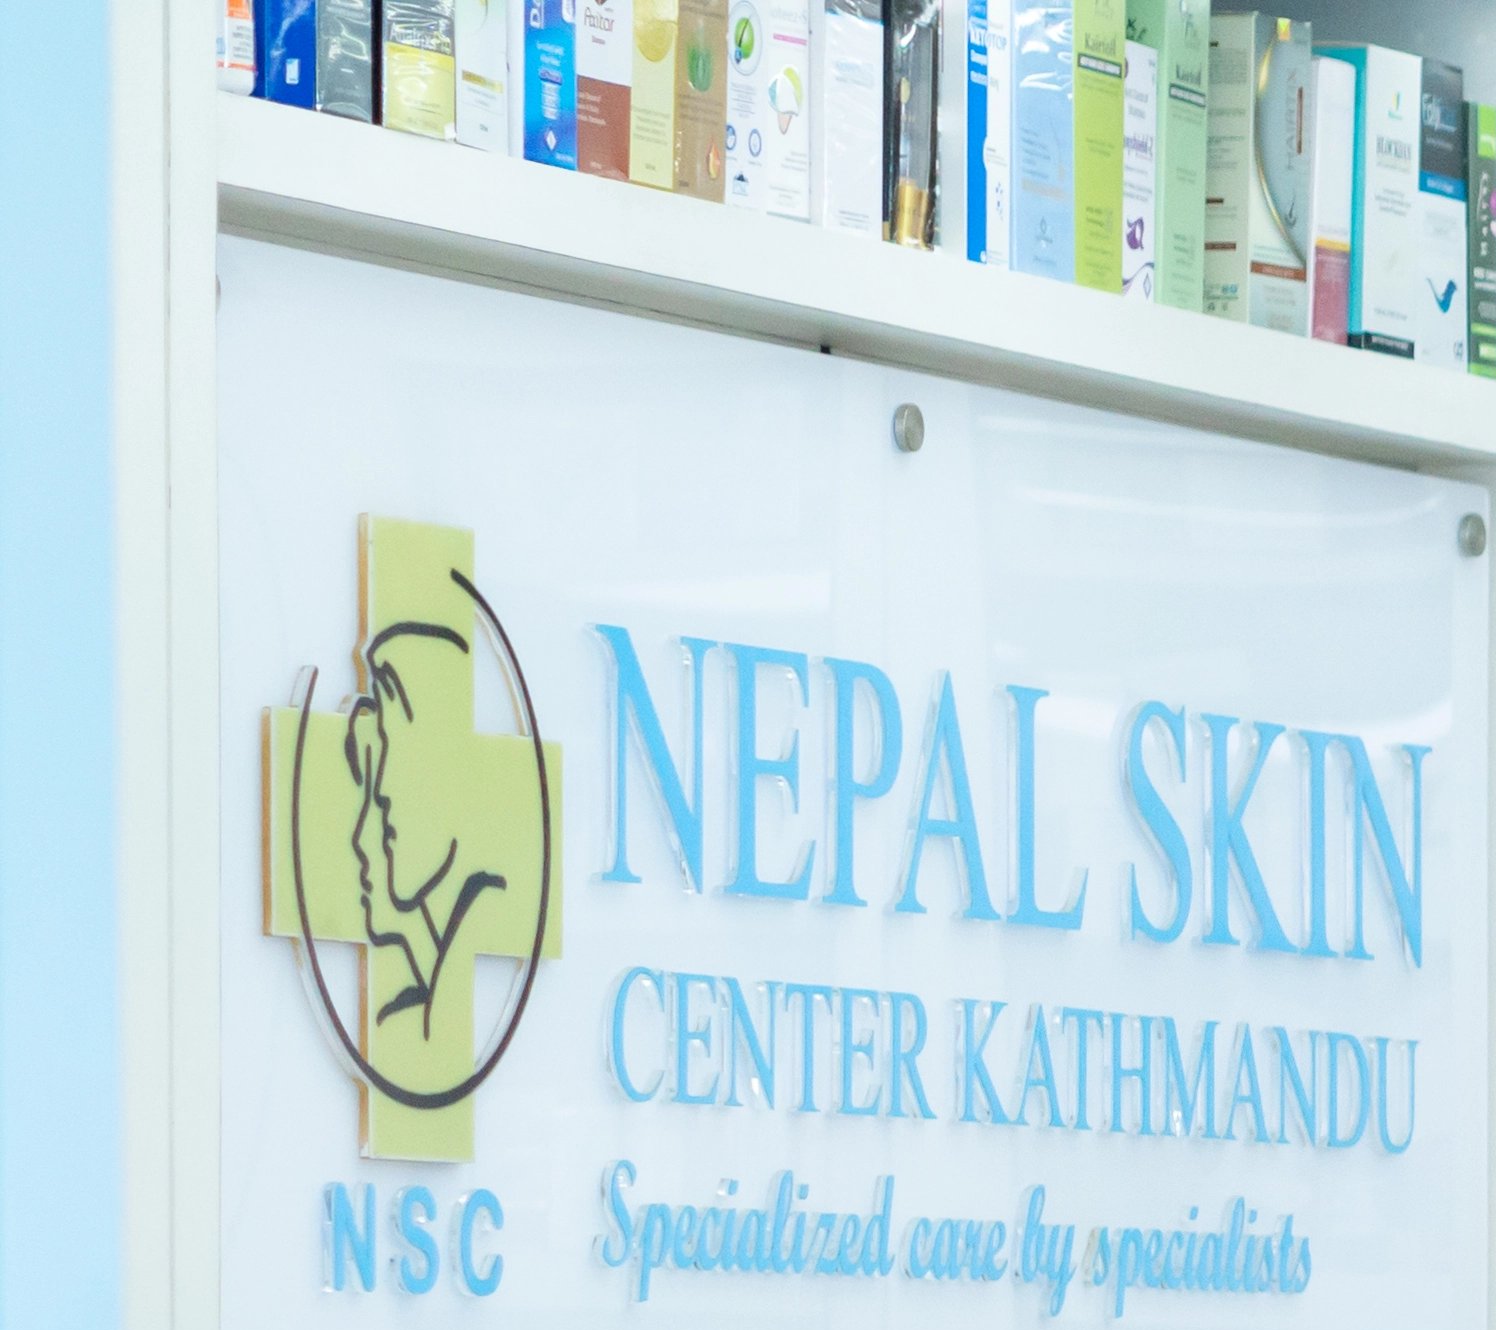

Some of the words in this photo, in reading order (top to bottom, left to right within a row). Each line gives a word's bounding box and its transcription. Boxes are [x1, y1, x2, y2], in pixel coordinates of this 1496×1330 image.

[588, 622, 1088, 934] NEPAL
[1118, 699, 1435, 970] SKIN
[605, 963, 936, 1122] CENTER
[954, 995, 1420, 1156] KATHMANDU
[319, 1179, 507, 1298] NSC
[592, 1157, 897, 1303] Specialized
[907, 1208, 1009, 1286] care
[1012, 1182, 1079, 1318] by
[1082, 1195, 1314, 1318] specialists
